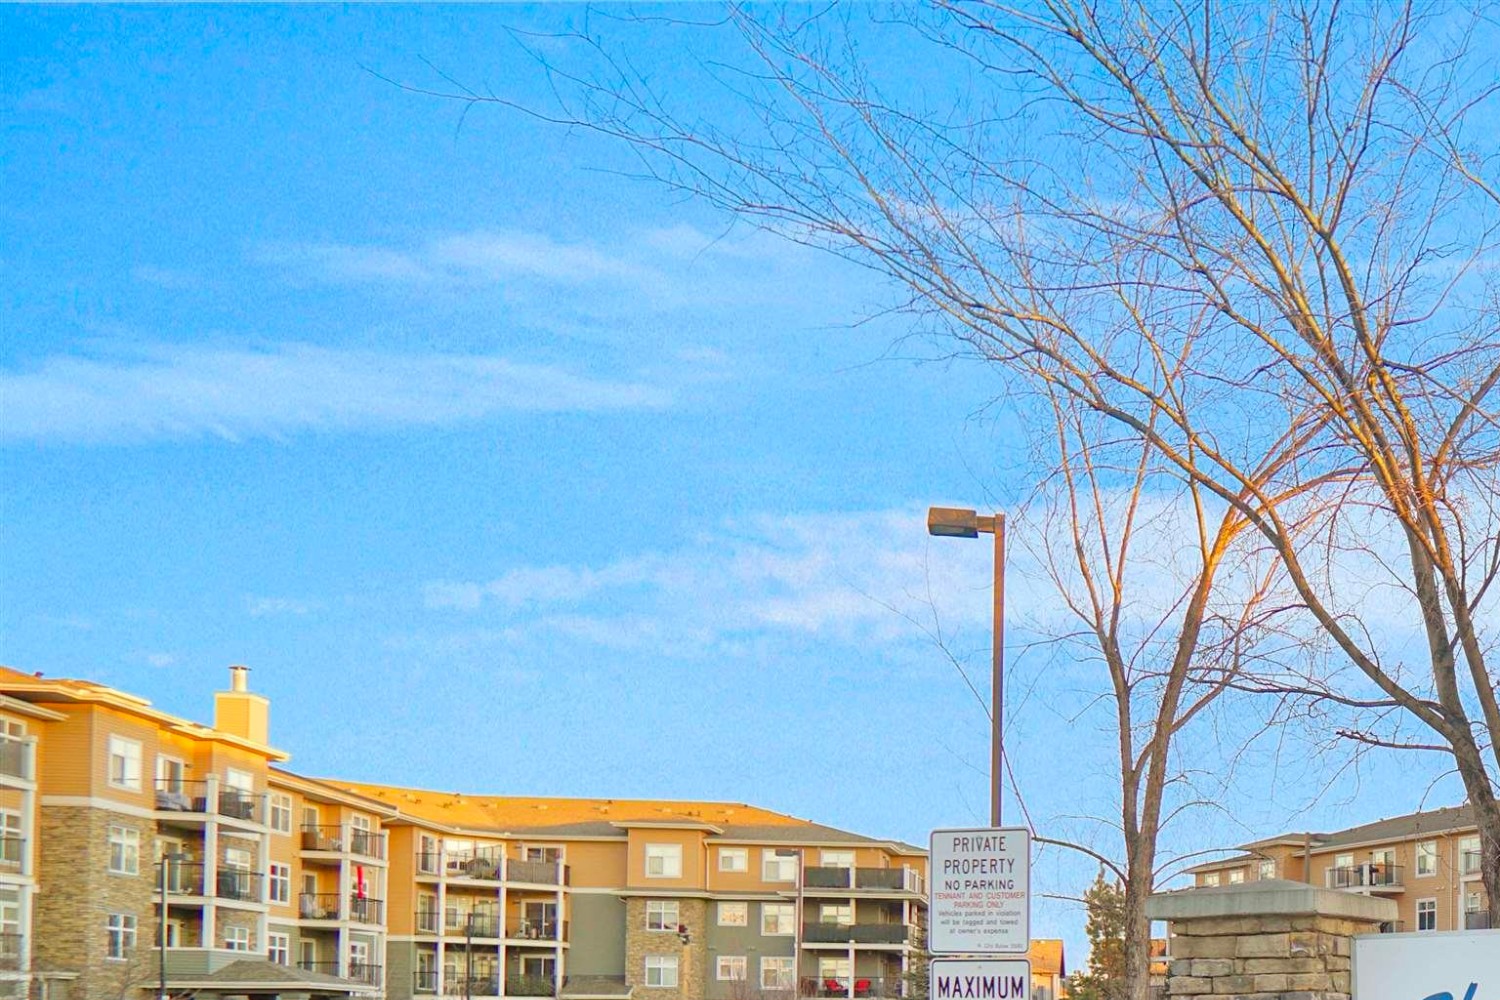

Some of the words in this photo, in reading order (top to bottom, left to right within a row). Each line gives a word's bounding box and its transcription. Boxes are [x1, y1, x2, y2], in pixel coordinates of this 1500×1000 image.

[953, 836, 1006, 852] PRIVATE
[944, 858, 1015, 874] PROPERTY
[945, 880, 960, 890] NO
[965, 880, 1014, 890] PARKING
[987, 891, 1025, 899] CUSTOMER
[938, 976, 1023, 999] MAXIMUM
